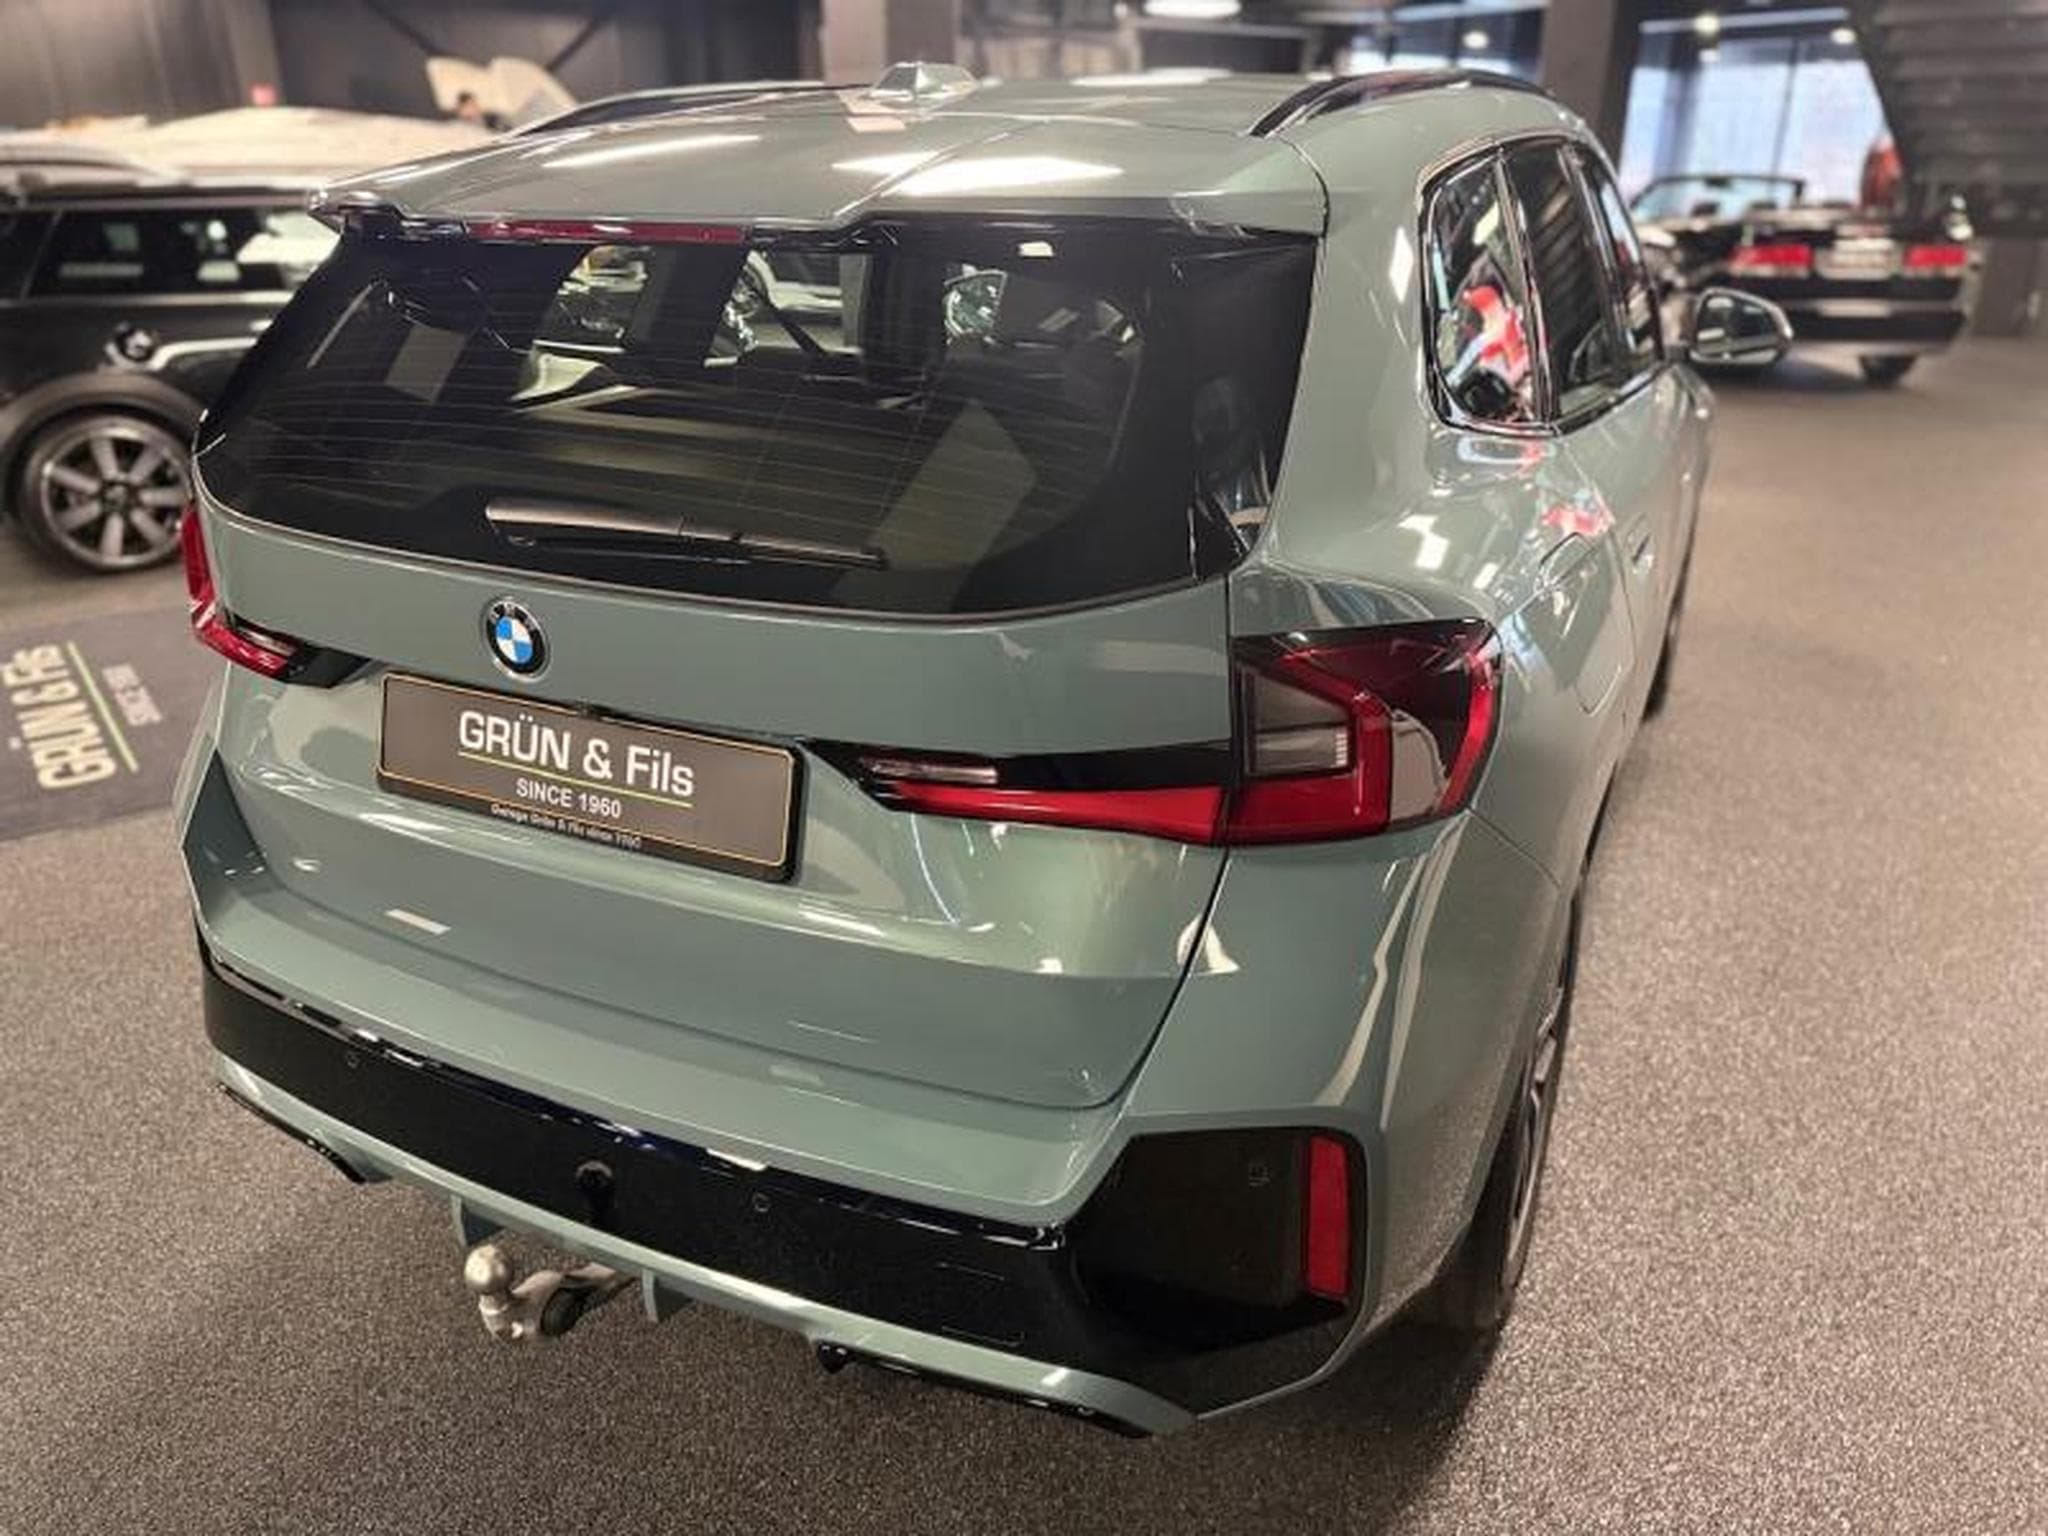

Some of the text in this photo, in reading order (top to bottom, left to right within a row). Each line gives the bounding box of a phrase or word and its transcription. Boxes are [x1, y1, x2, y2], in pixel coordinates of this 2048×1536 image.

[458, 710, 696, 797] GRÜN & Fils
[515, 777, 622, 820] SINCE 1960
